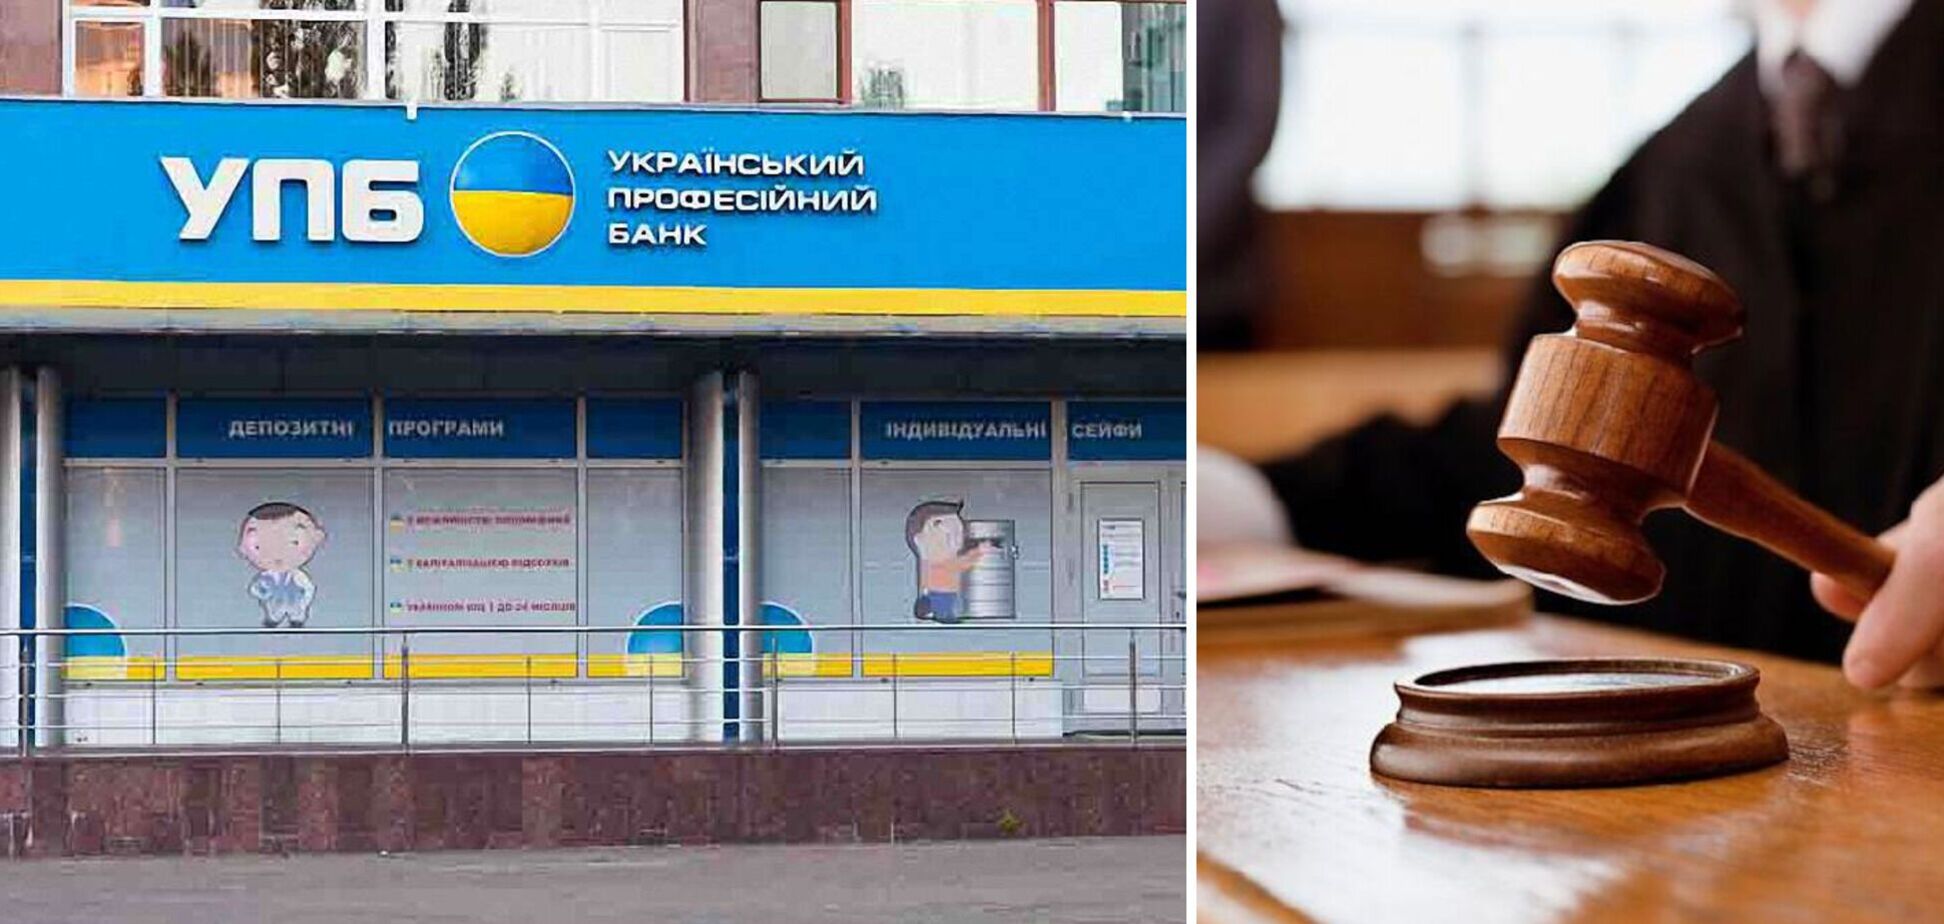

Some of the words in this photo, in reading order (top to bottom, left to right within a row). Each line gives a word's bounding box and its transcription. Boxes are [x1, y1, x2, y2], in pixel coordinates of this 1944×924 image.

[608, 147, 865, 176] УКРАЇНСЬКИЙ
[159, 156, 424, 242] УПБ
[608, 185, 878, 212] ПРОФЕСІЙНИЙ
[608, 223, 708, 246] БАНК
[228, 420, 354, 438] ДЕПОЗИТНІ
[388, 420, 505, 437] ПРОГРАМИ
[885, 421, 1047, 441] ІНДИВІДУАЛЬНІ
[1071, 422, 1143, 439] СЕЙФИ
